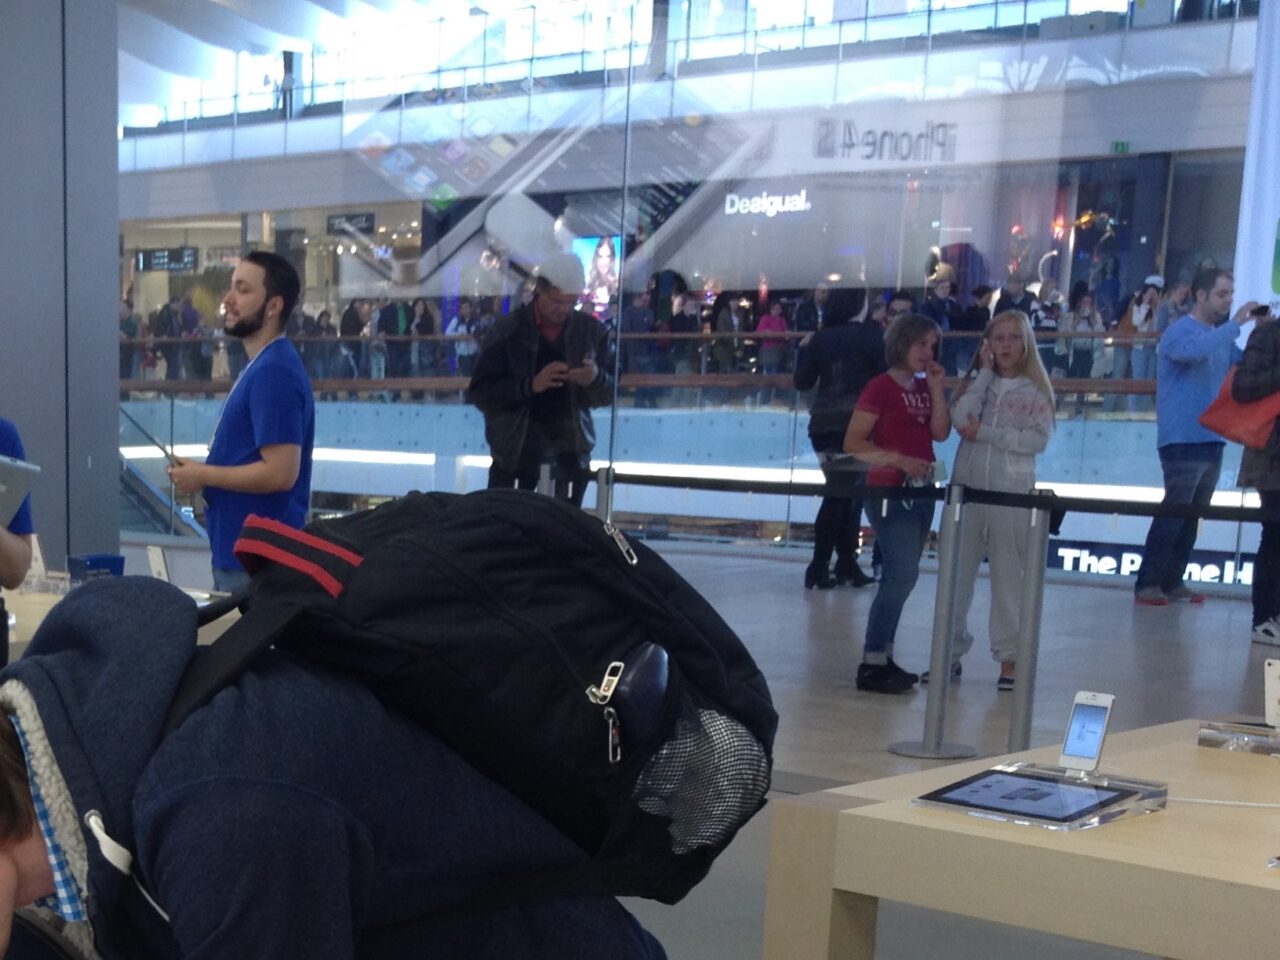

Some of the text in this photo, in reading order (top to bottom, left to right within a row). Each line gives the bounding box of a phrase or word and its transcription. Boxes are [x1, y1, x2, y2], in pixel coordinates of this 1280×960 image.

[1058, 548, 1255, 585] The Pne H
